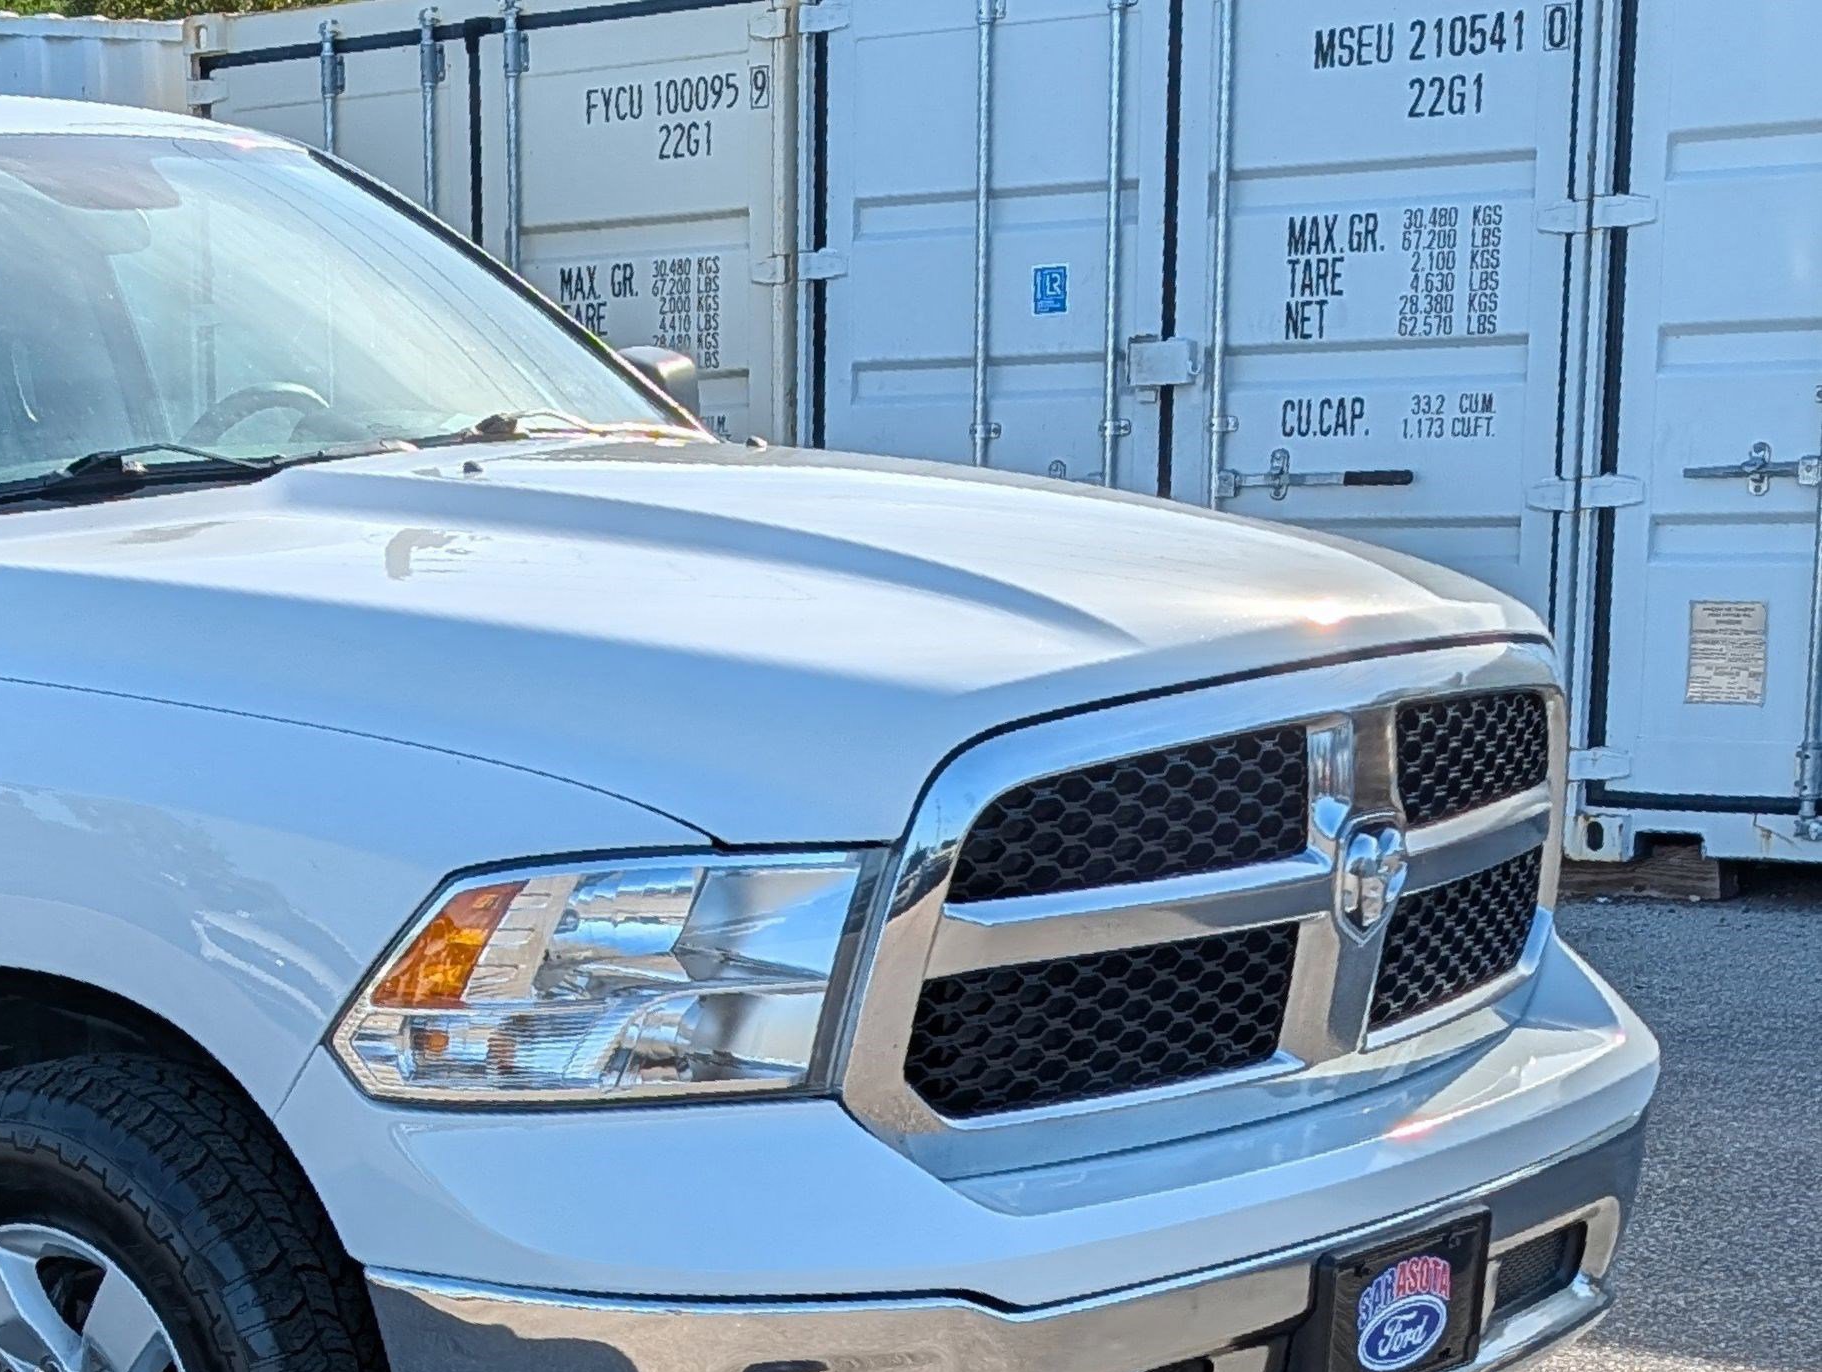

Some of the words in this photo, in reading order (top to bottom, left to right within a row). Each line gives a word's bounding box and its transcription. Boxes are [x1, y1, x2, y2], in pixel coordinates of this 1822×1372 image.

[1314, 22, 1394, 69] MSEU
[1408, 9, 1525, 61] 210541
[1547, 6, 1568, 48] 0
[586, 84, 642, 125] FYCU
[654, 73, 739, 116] 100095
[753, 70, 767, 105] 9
[1408, 72, 1483, 118] 22G1
[658, 120, 712, 160] 22G1
[1472, 205, 1503, 226] KGS
[1471, 227, 1501, 248] LBS
[559, 265, 601, 302] MAX.
[610, 262, 639, 298] GR.
[696, 256, 720, 275] KGS
[696, 275, 720, 295] LBS
[1287, 256, 1345, 298] TARE
[1469, 249, 1500, 270] KGS
[1469, 271, 1499, 292] LBS
[696, 295, 720, 313] KGS
[696, 313, 720, 332] LBS
[1284, 299, 1329, 340] NET
[1468, 293, 1498, 313] KGS
[652, 333, 691, 350] 28480
[696, 332, 720, 350] KGS
[1466, 314, 1497, 336] LBS
[1281, 396, 1370, 438] CU.CAP.
[1357, 1256, 1450, 1331] SARASOTA
[1378, 1310, 1428, 1357] Ford
